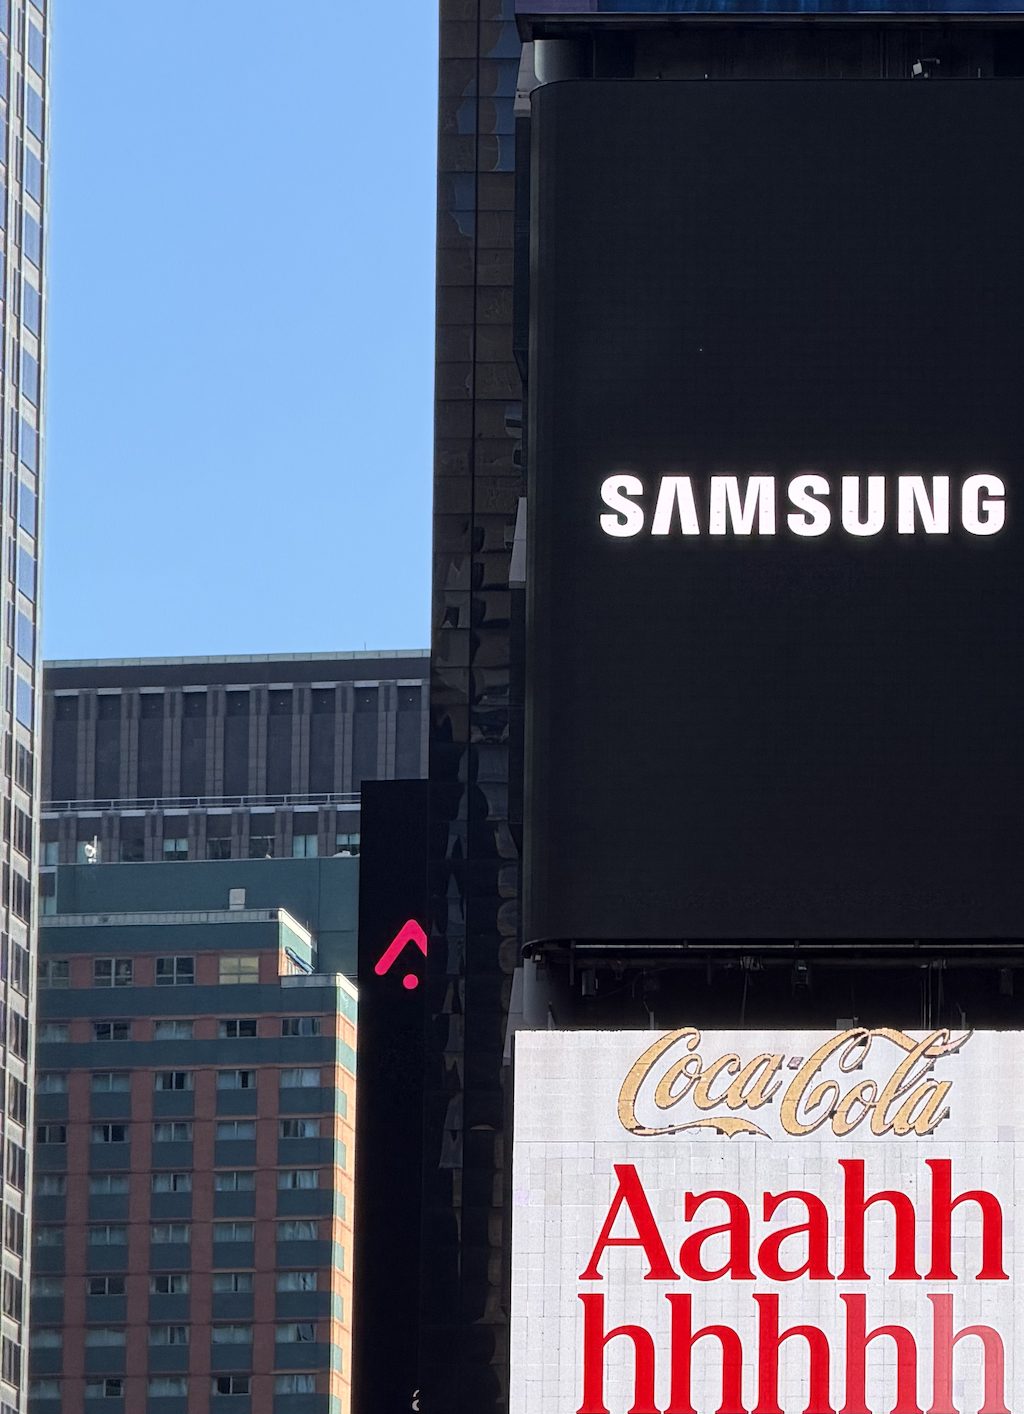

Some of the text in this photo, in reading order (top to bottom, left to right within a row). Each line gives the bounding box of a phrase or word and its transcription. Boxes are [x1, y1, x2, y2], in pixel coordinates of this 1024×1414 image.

[599, 473, 1006, 538] SAMSUNG
[617, 1027, 973, 1138] Coca-Cola
[578, 1158, 1010, 1280] Aaahh
[575, 1293, 1011, 1414] hhhhh
